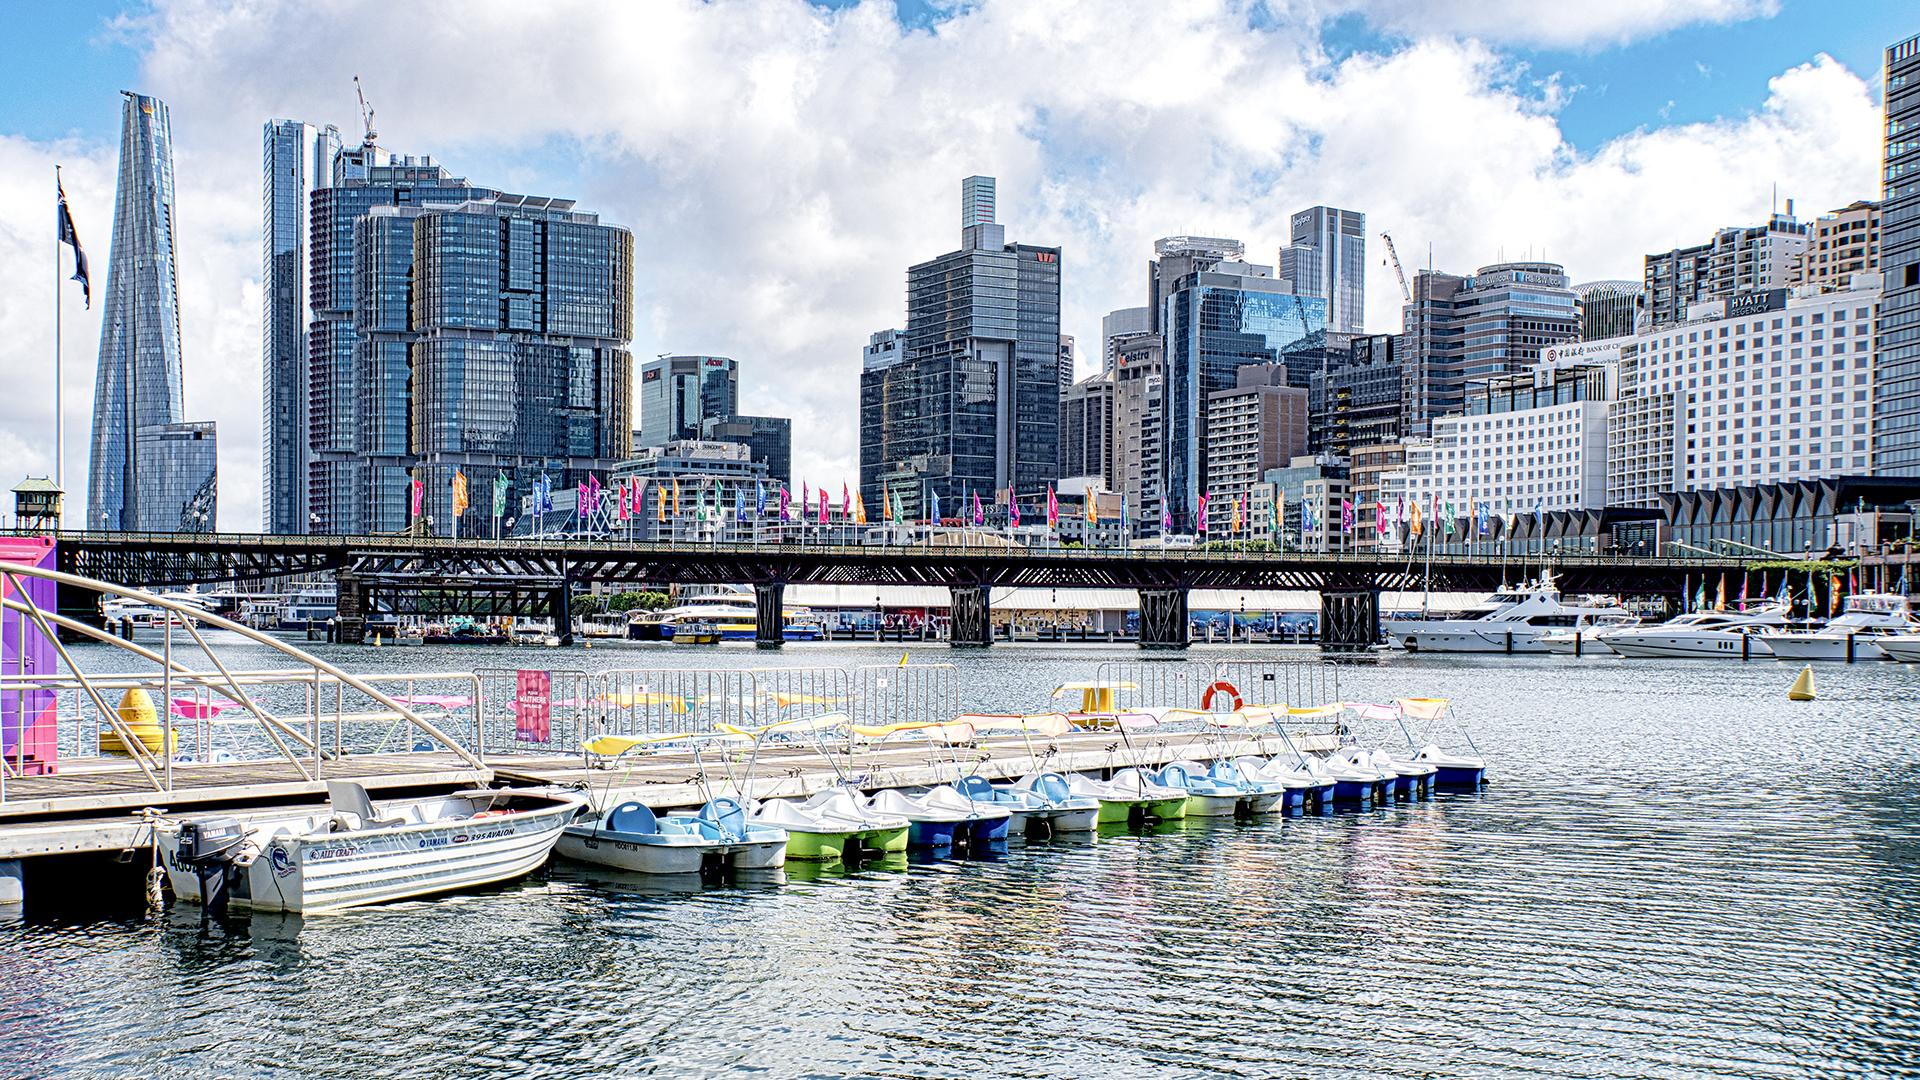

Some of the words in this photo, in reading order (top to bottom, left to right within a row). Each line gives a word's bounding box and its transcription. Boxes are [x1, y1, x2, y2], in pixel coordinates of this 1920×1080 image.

[1731, 292, 1770, 308] HYATT
[1731, 304, 1769, 316] REGENCY
[1586, 345, 1602, 353] BANK
[1119, 351, 1150, 368] Telstra
[203, 828, 226, 839] YAMAHA
[470, 832, 485, 842] 395
[486, 828, 515, 839] AVALON
[180, 836, 193, 845] 25
[426, 837, 448, 847] YAMAHA
[320, 849, 335, 859] ALLY
[335, 847, 355, 858] CRAFT
